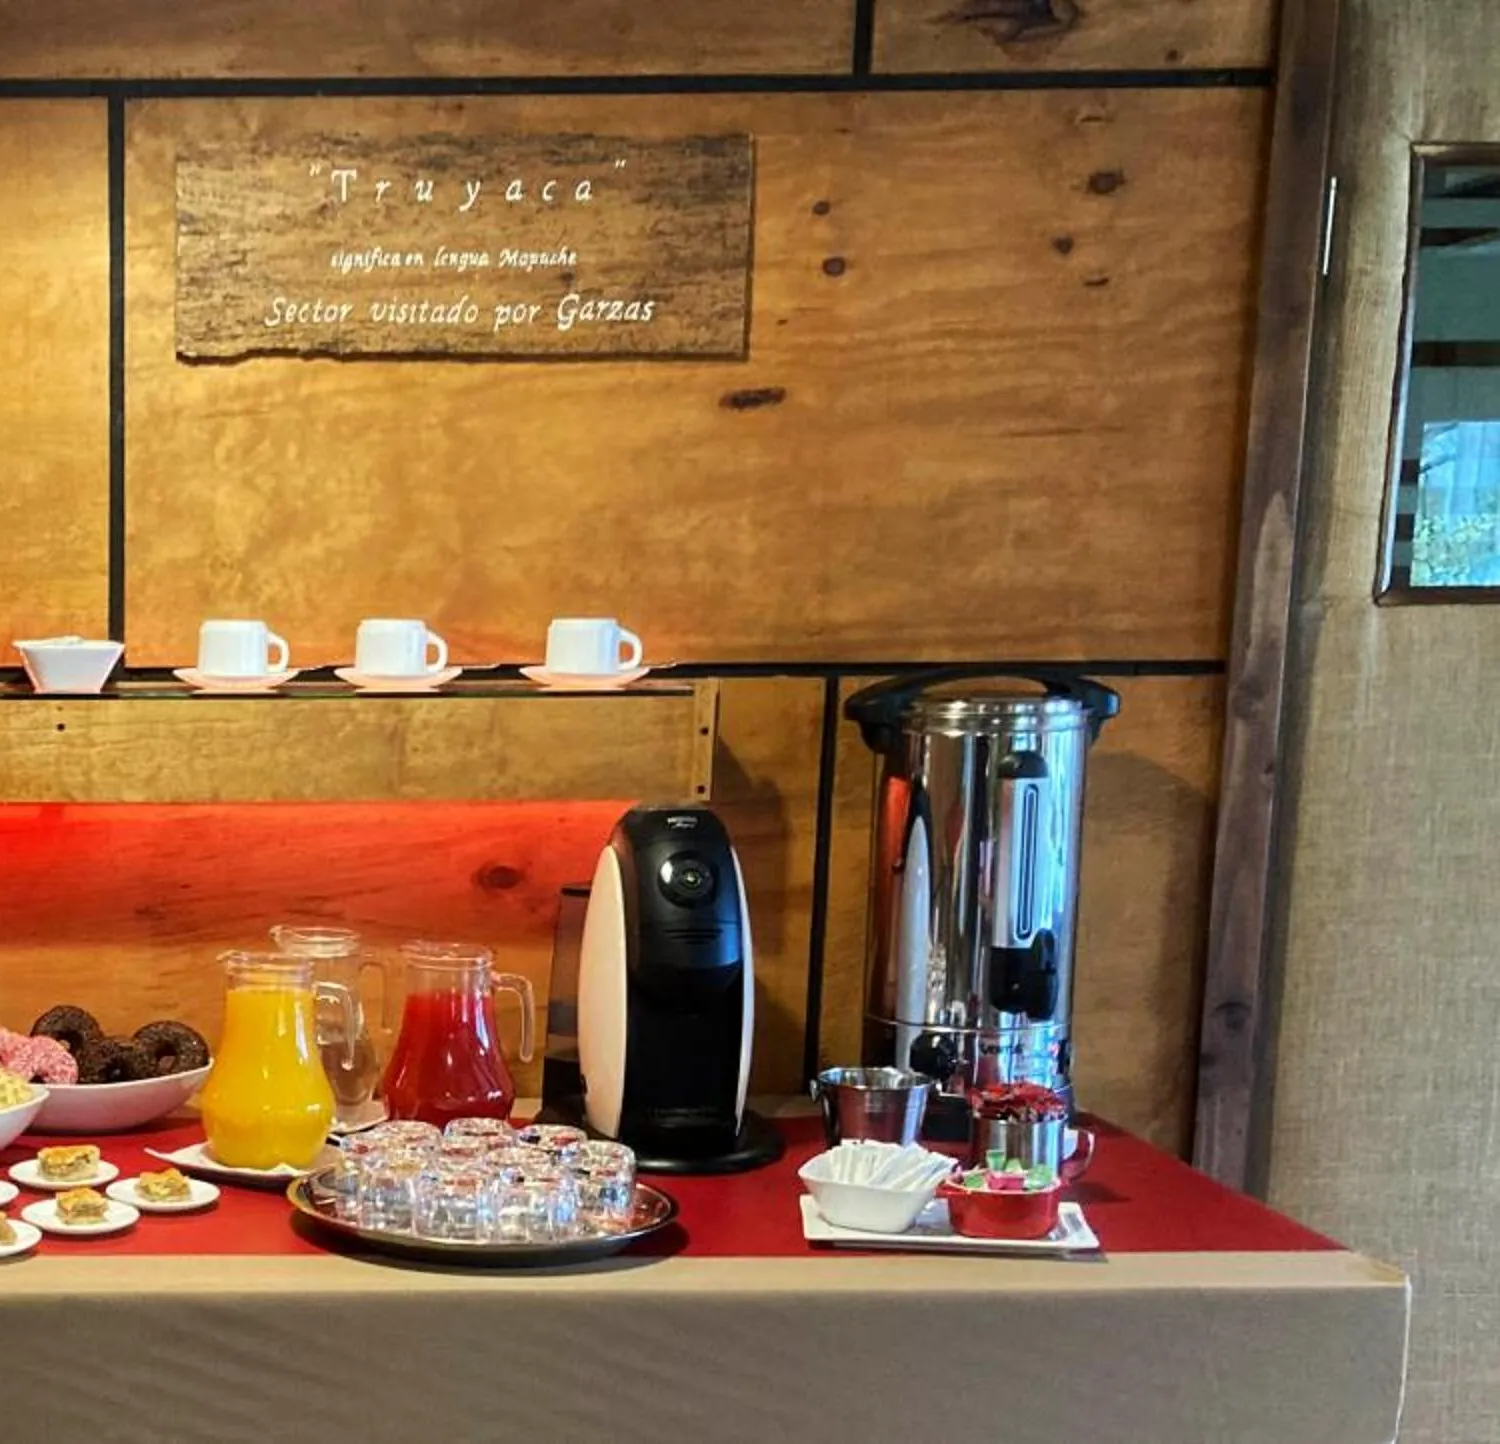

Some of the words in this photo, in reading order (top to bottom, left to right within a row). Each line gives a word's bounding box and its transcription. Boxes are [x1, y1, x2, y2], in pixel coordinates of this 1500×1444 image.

[330, 246, 401, 274] significa
[405, 252, 424, 267] en
[434, 246, 490, 273] lengua
[264, 296, 353, 327] Sector
[371, 295, 479, 325] visitado
[493, 302, 541, 332] por
[556, 293, 657, 332] Garzas
